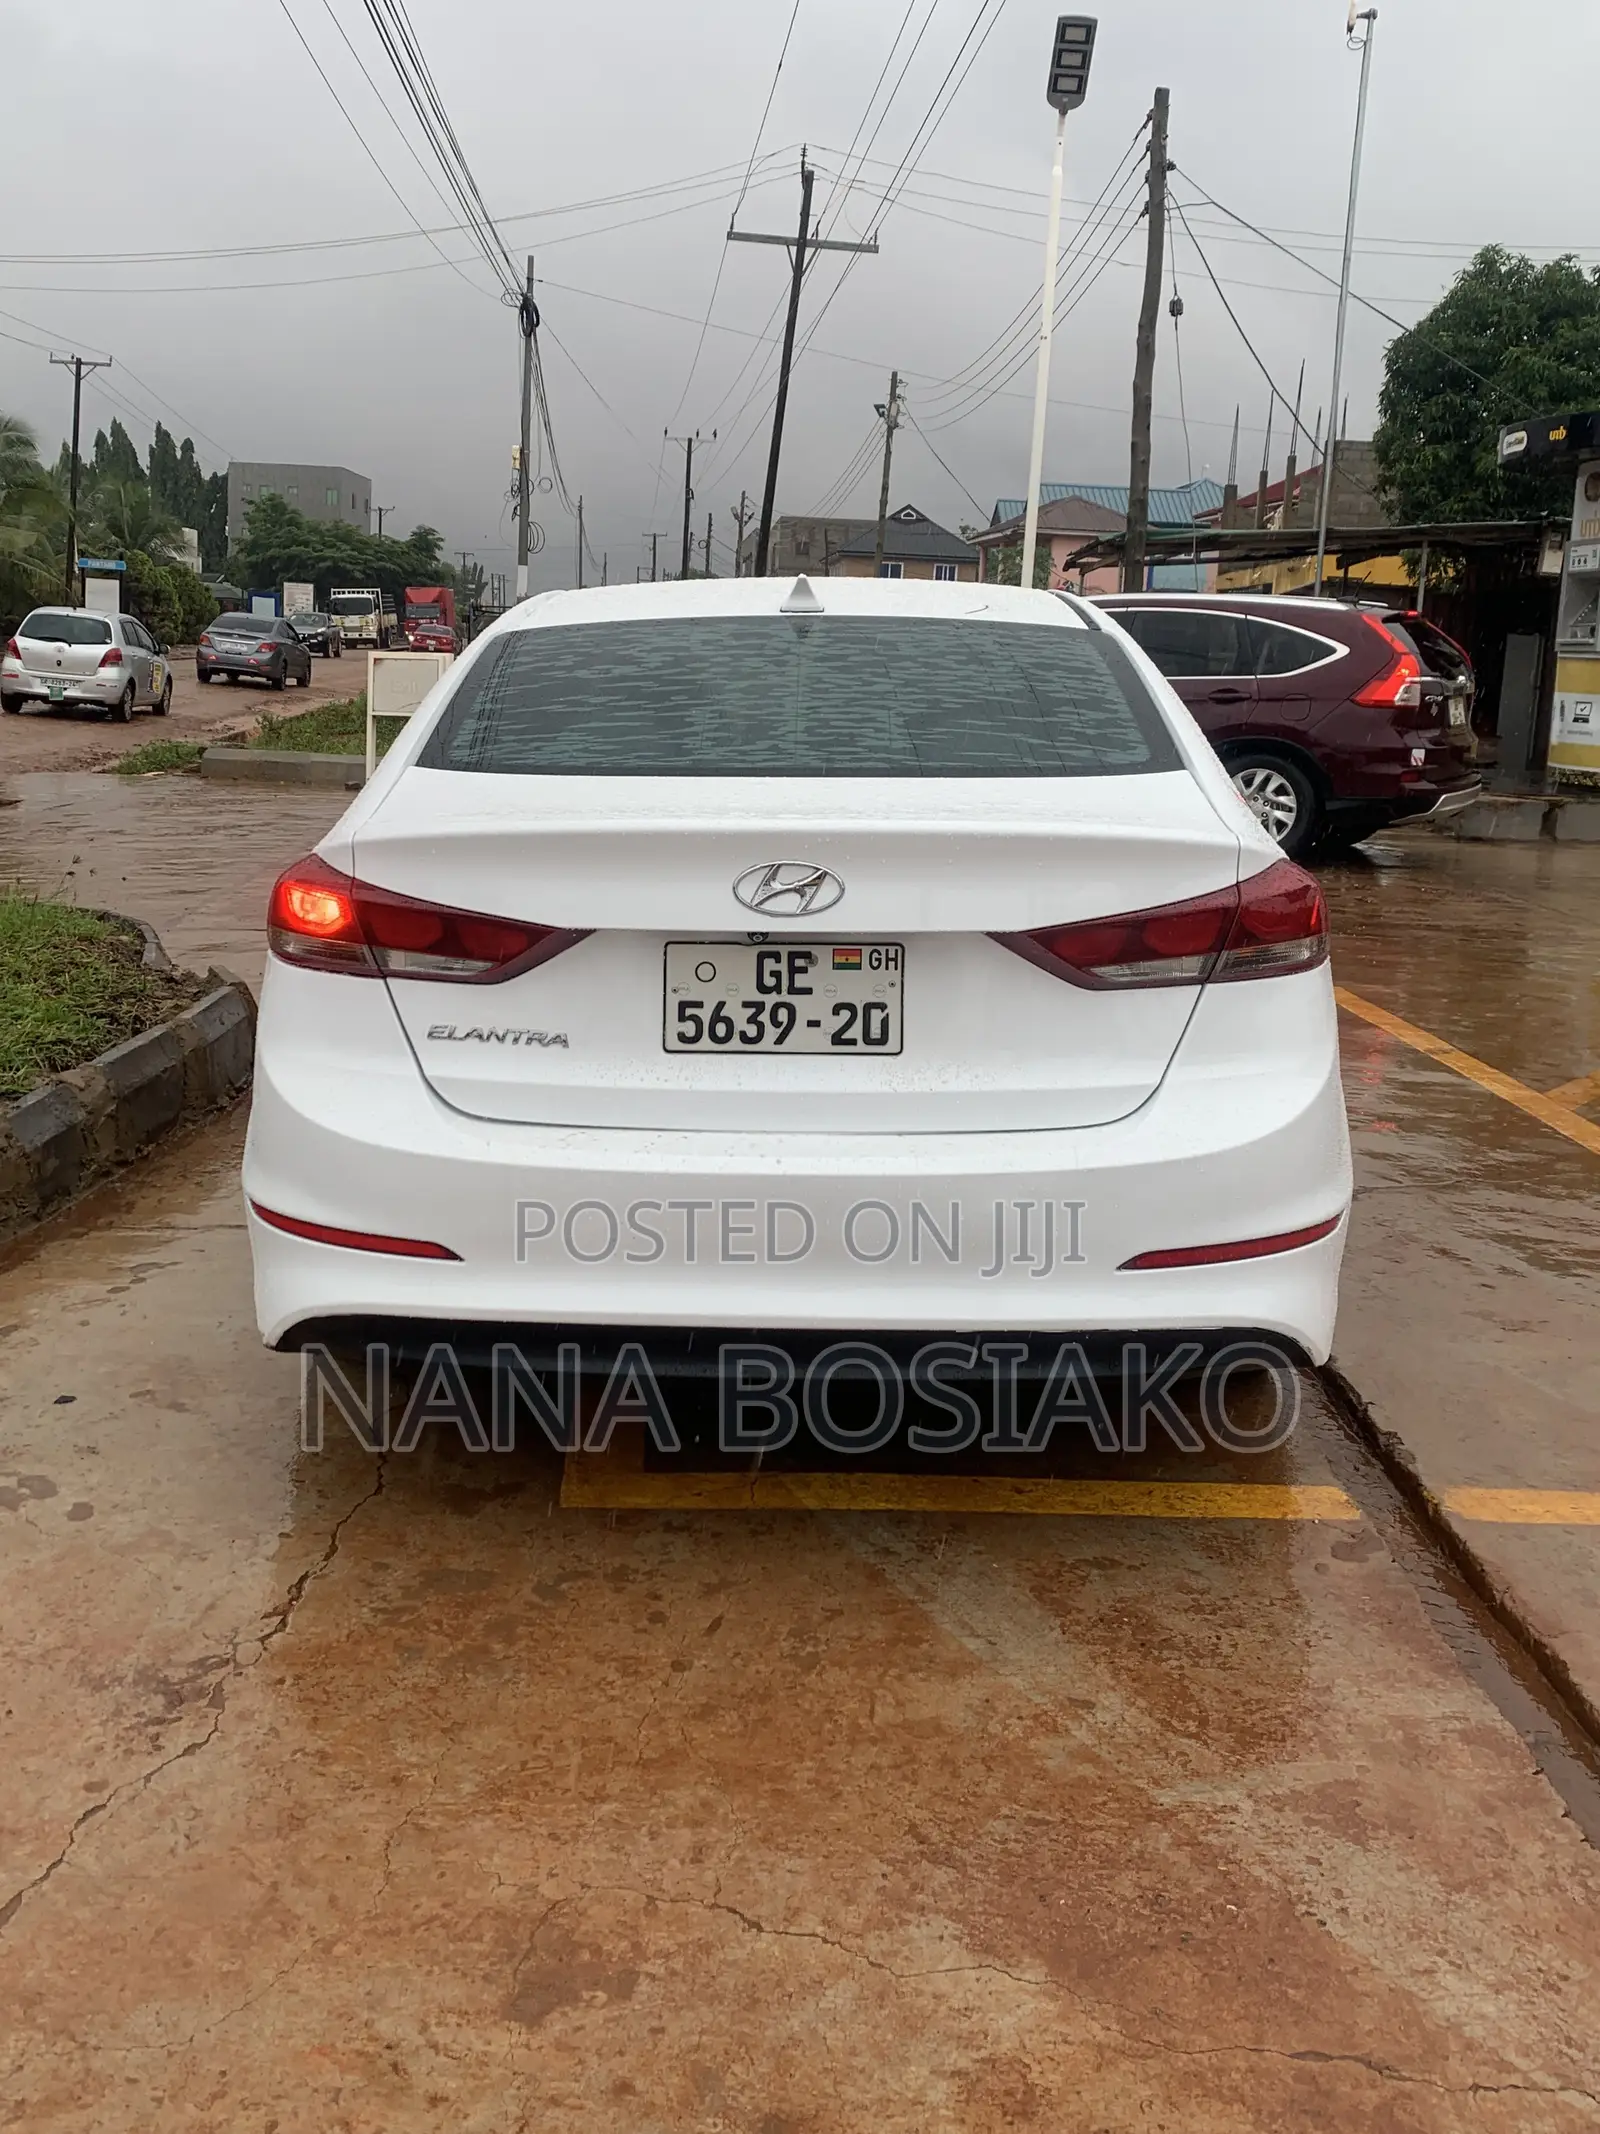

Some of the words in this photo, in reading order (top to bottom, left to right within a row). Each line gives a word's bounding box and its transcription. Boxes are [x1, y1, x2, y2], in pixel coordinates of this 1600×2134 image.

[756, 950, 814, 995] GE
[868, 948, 899, 971] GH
[426, 1024, 570, 1049] ELANTRA
[677, 1001, 890, 1046] 5639-20
